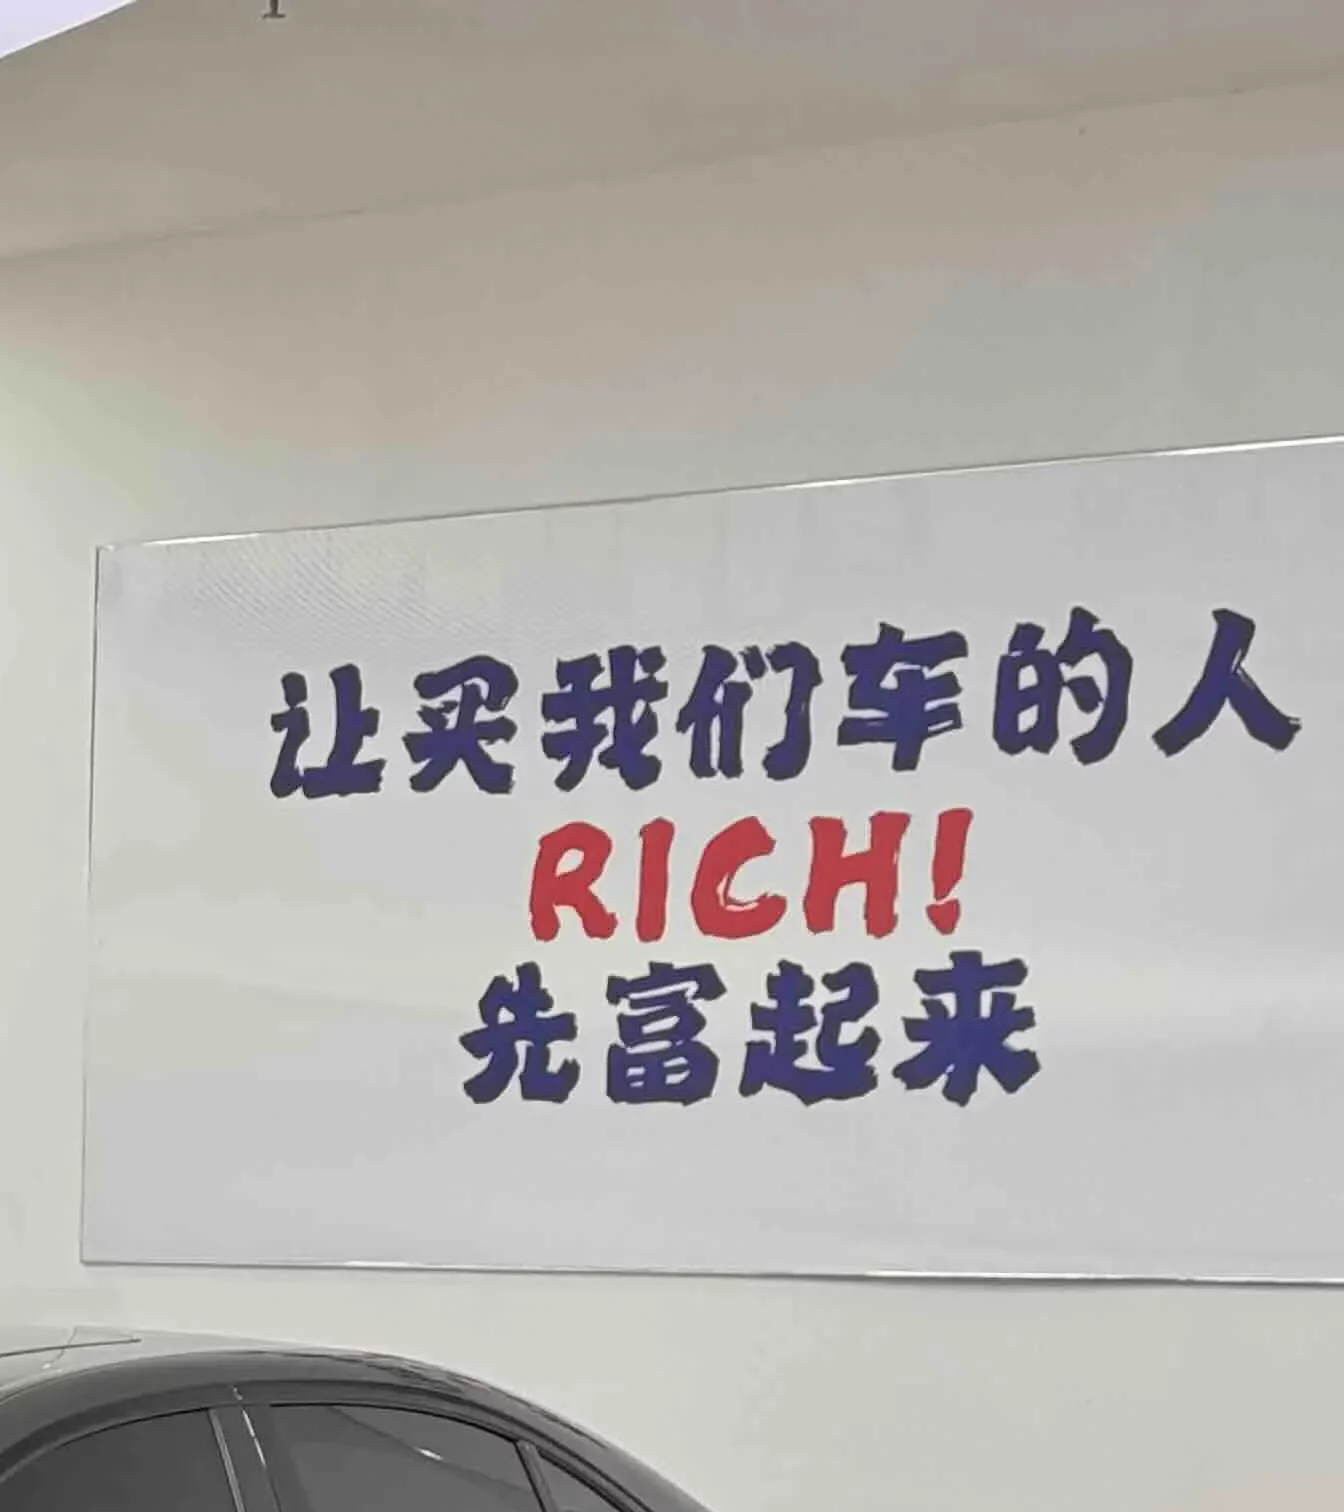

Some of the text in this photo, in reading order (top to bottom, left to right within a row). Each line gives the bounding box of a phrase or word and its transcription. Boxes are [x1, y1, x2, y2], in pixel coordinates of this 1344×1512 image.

[269, 608, 1302, 798] 让买我们车的人
[529, 808, 973, 942] RICH!
[458, 950, 1043, 1106] 先富起来
